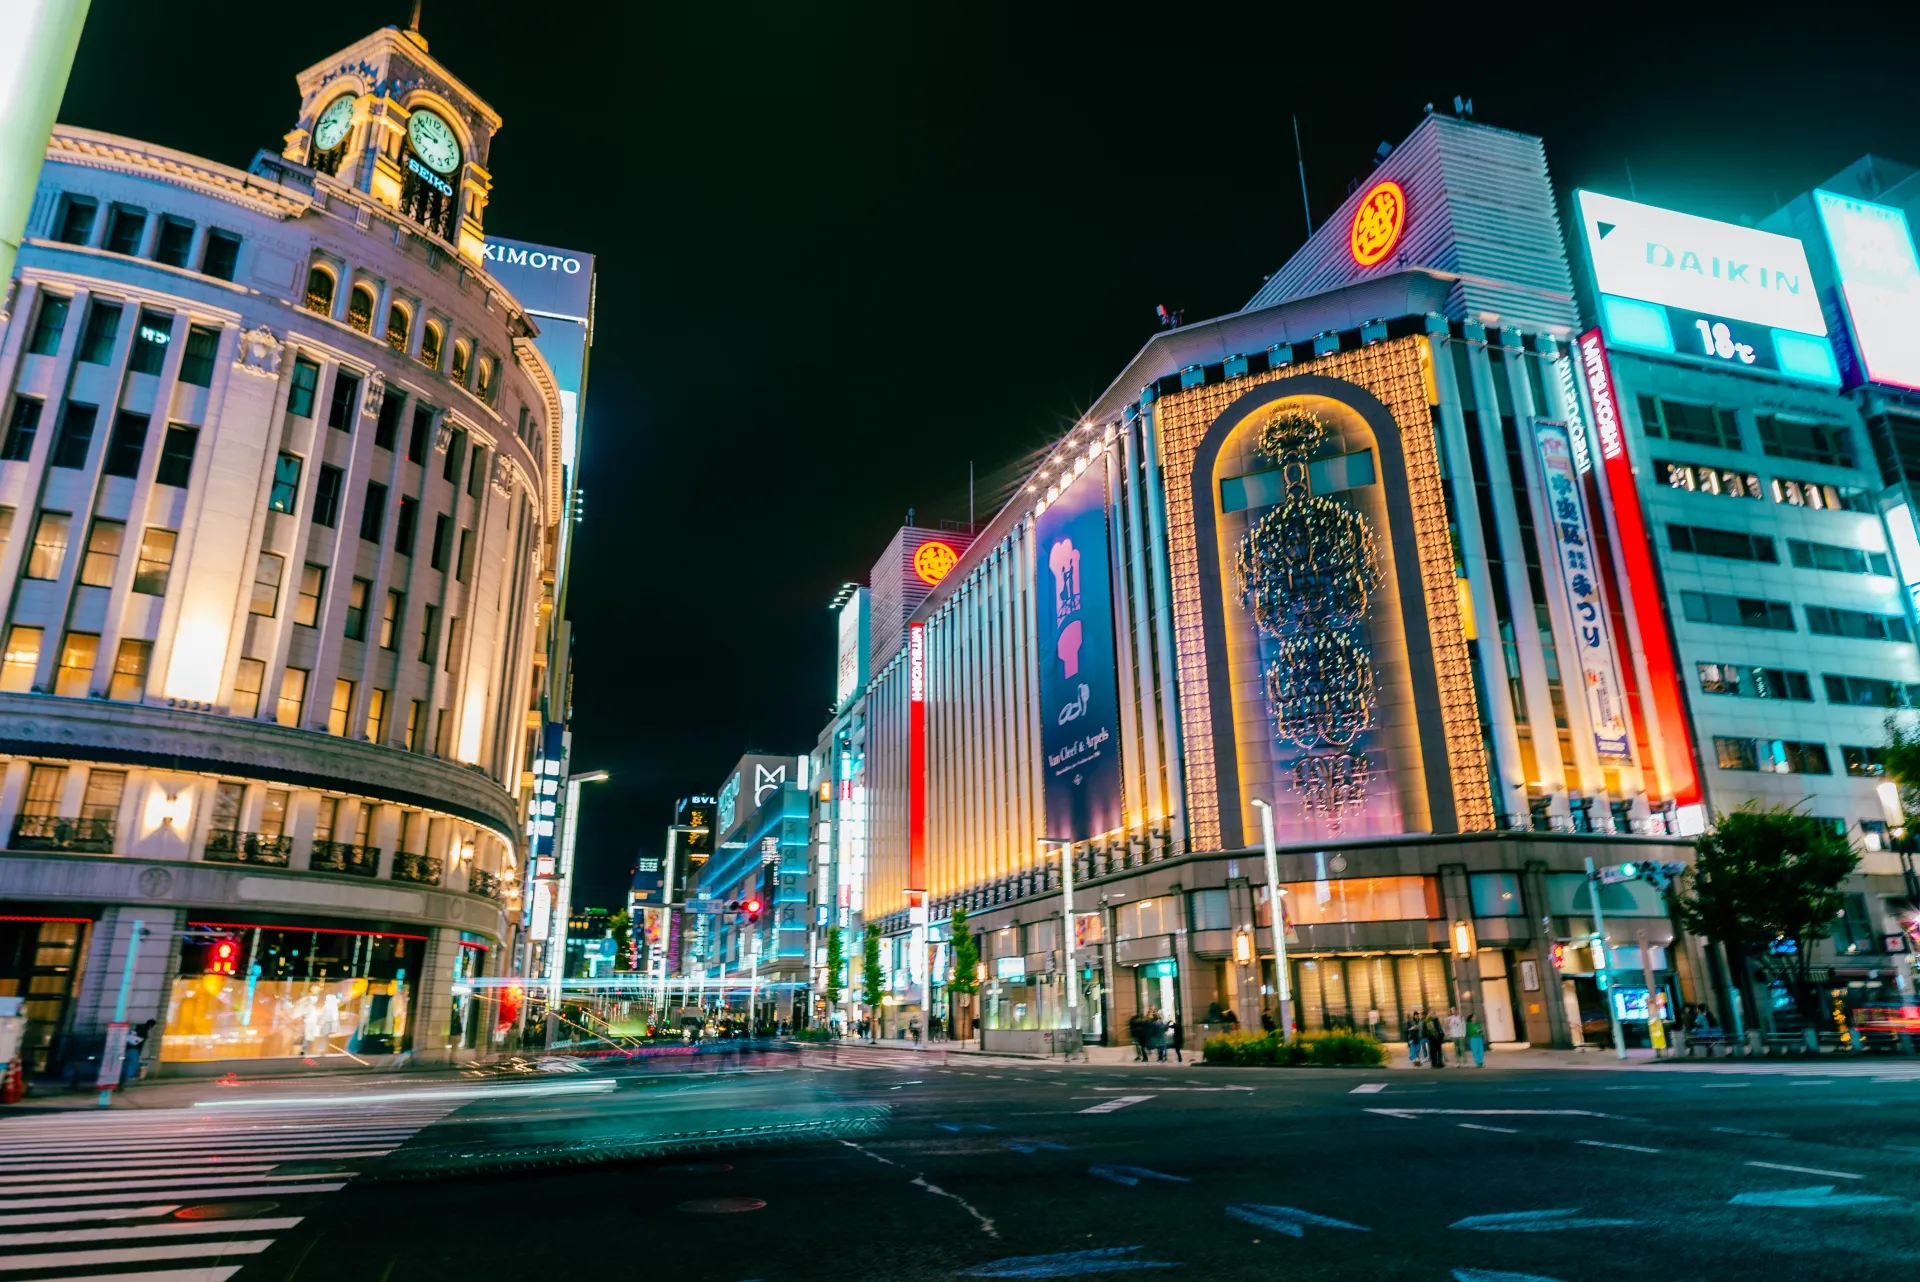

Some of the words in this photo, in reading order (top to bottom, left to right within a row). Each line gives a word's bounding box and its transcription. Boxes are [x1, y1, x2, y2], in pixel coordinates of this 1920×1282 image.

[408, 158, 453, 196] SEIKO
[483, 243, 580, 274] KIMOTO
[1646, 242, 1799, 295] DAIKIN
[1583, 337, 1621, 460] MITSUKOSHI
[911, 626, 923, 701] MITSUKOSHI
[692, 796, 717, 804] BVL
